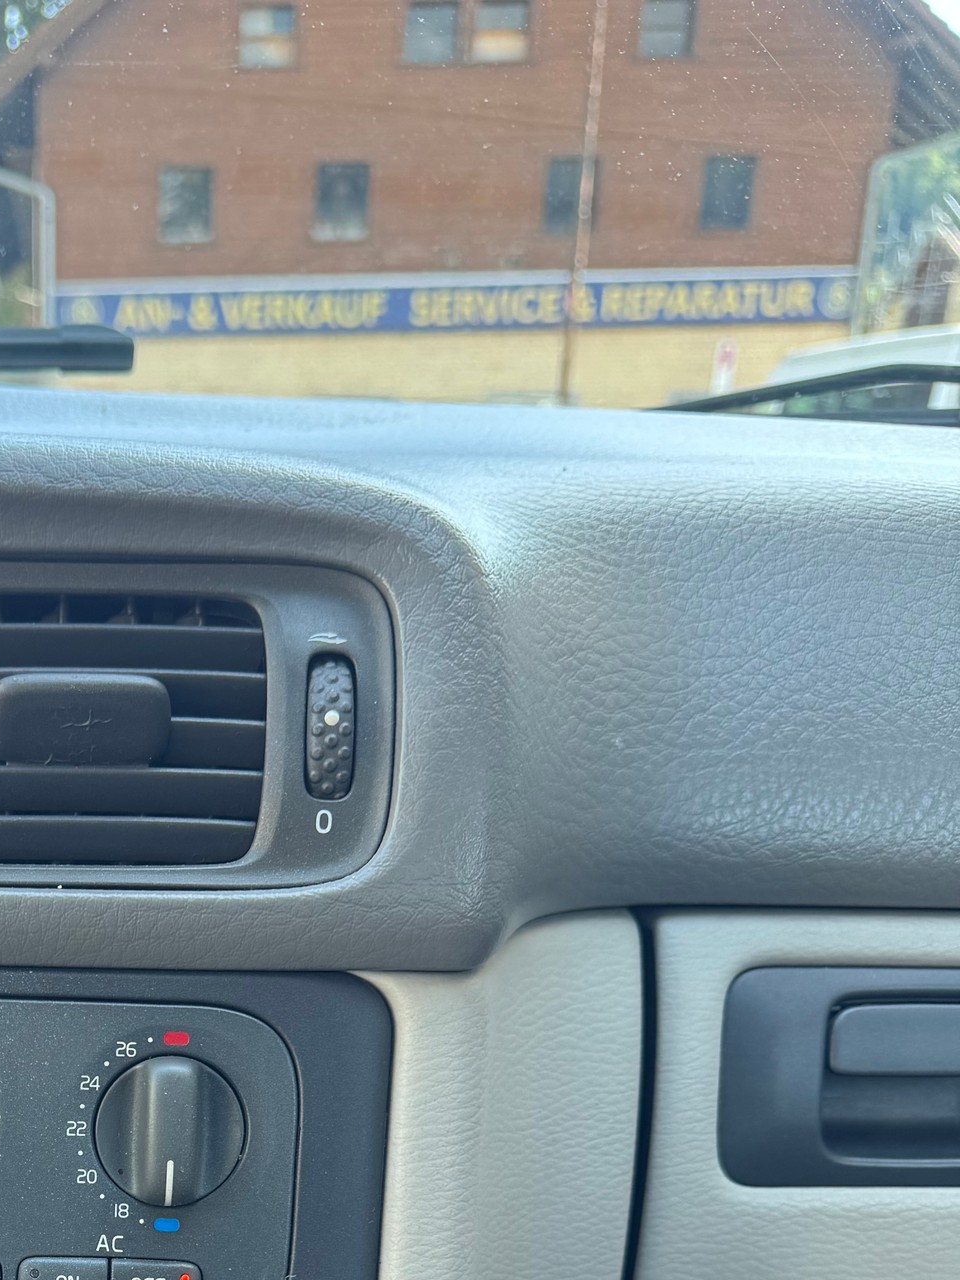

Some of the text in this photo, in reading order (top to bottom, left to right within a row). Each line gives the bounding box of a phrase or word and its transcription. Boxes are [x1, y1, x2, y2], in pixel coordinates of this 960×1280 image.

[187, 292, 218, 330] &
[220, 288, 388, 330] VERKAUF
[408, 285, 564, 328] SERVICE
[600, 279, 816, 323] REPARATUR
[116, 1042, 137, 1058] 26
[80, 1075, 101, 1092] 24
[67, 1121, 87, 1137] 22
[76, 1169, 98, 1186] 20
[114, 1203, 129, 1219] 18
[96, 1234, 125, 1254] AC
